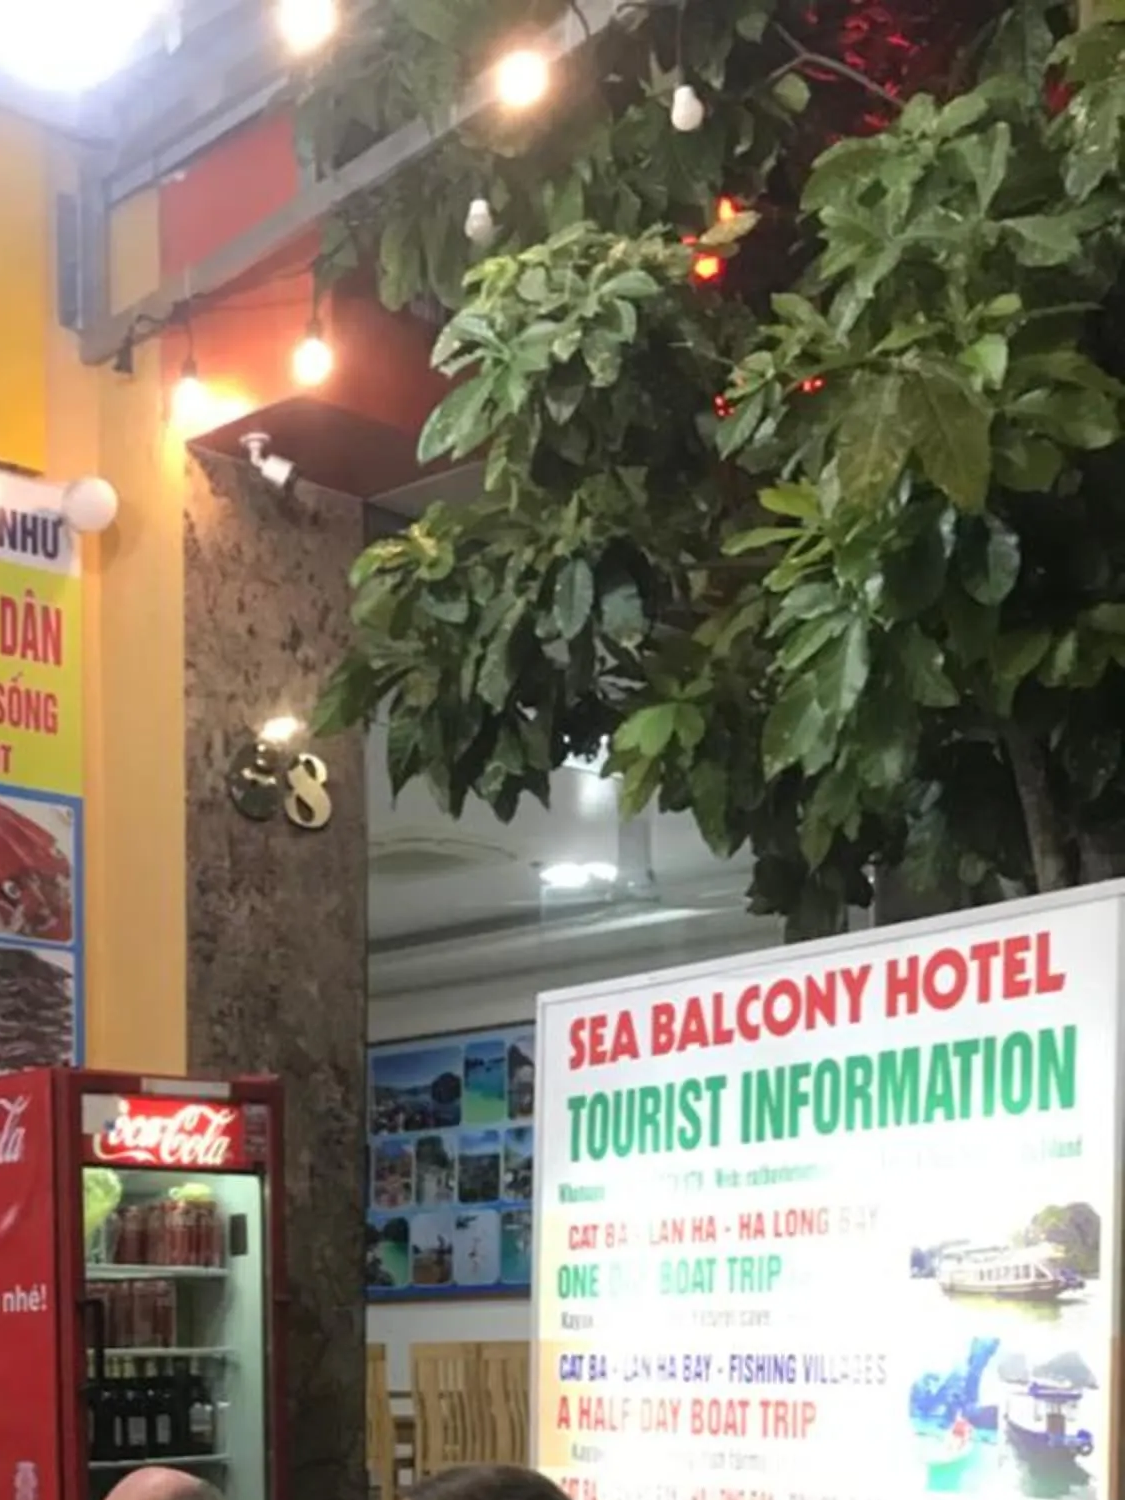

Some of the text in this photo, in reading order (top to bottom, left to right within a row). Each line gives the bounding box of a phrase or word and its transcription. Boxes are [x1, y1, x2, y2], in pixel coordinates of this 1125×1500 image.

[0, 588, 63, 668] DÂN
[568, 930, 1067, 1071] SEA BALCONY HOTEL
[567, 1023, 1079, 1164] TOURIST INFORMATION
[568, 1224, 600, 1251] CAT
[691, 1214, 718, 1244] HA
[738, 1211, 767, 1241] HA
[772, 1206, 830, 1238] LONG
[557, 1263, 600, 1300] ONE
[659, 1256, 718, 1296] BOAT
[725, 1253, 783, 1295] TRIP
[559, 1353, 585, 1382] CAT
[587, 1354, 608, 1381] BA
[682, 1353, 713, 1383] BAY
[728, 1353, 797, 1384] FISHING
[557, 1395, 819, 1441] A HALF DAY BOAT TRIP
